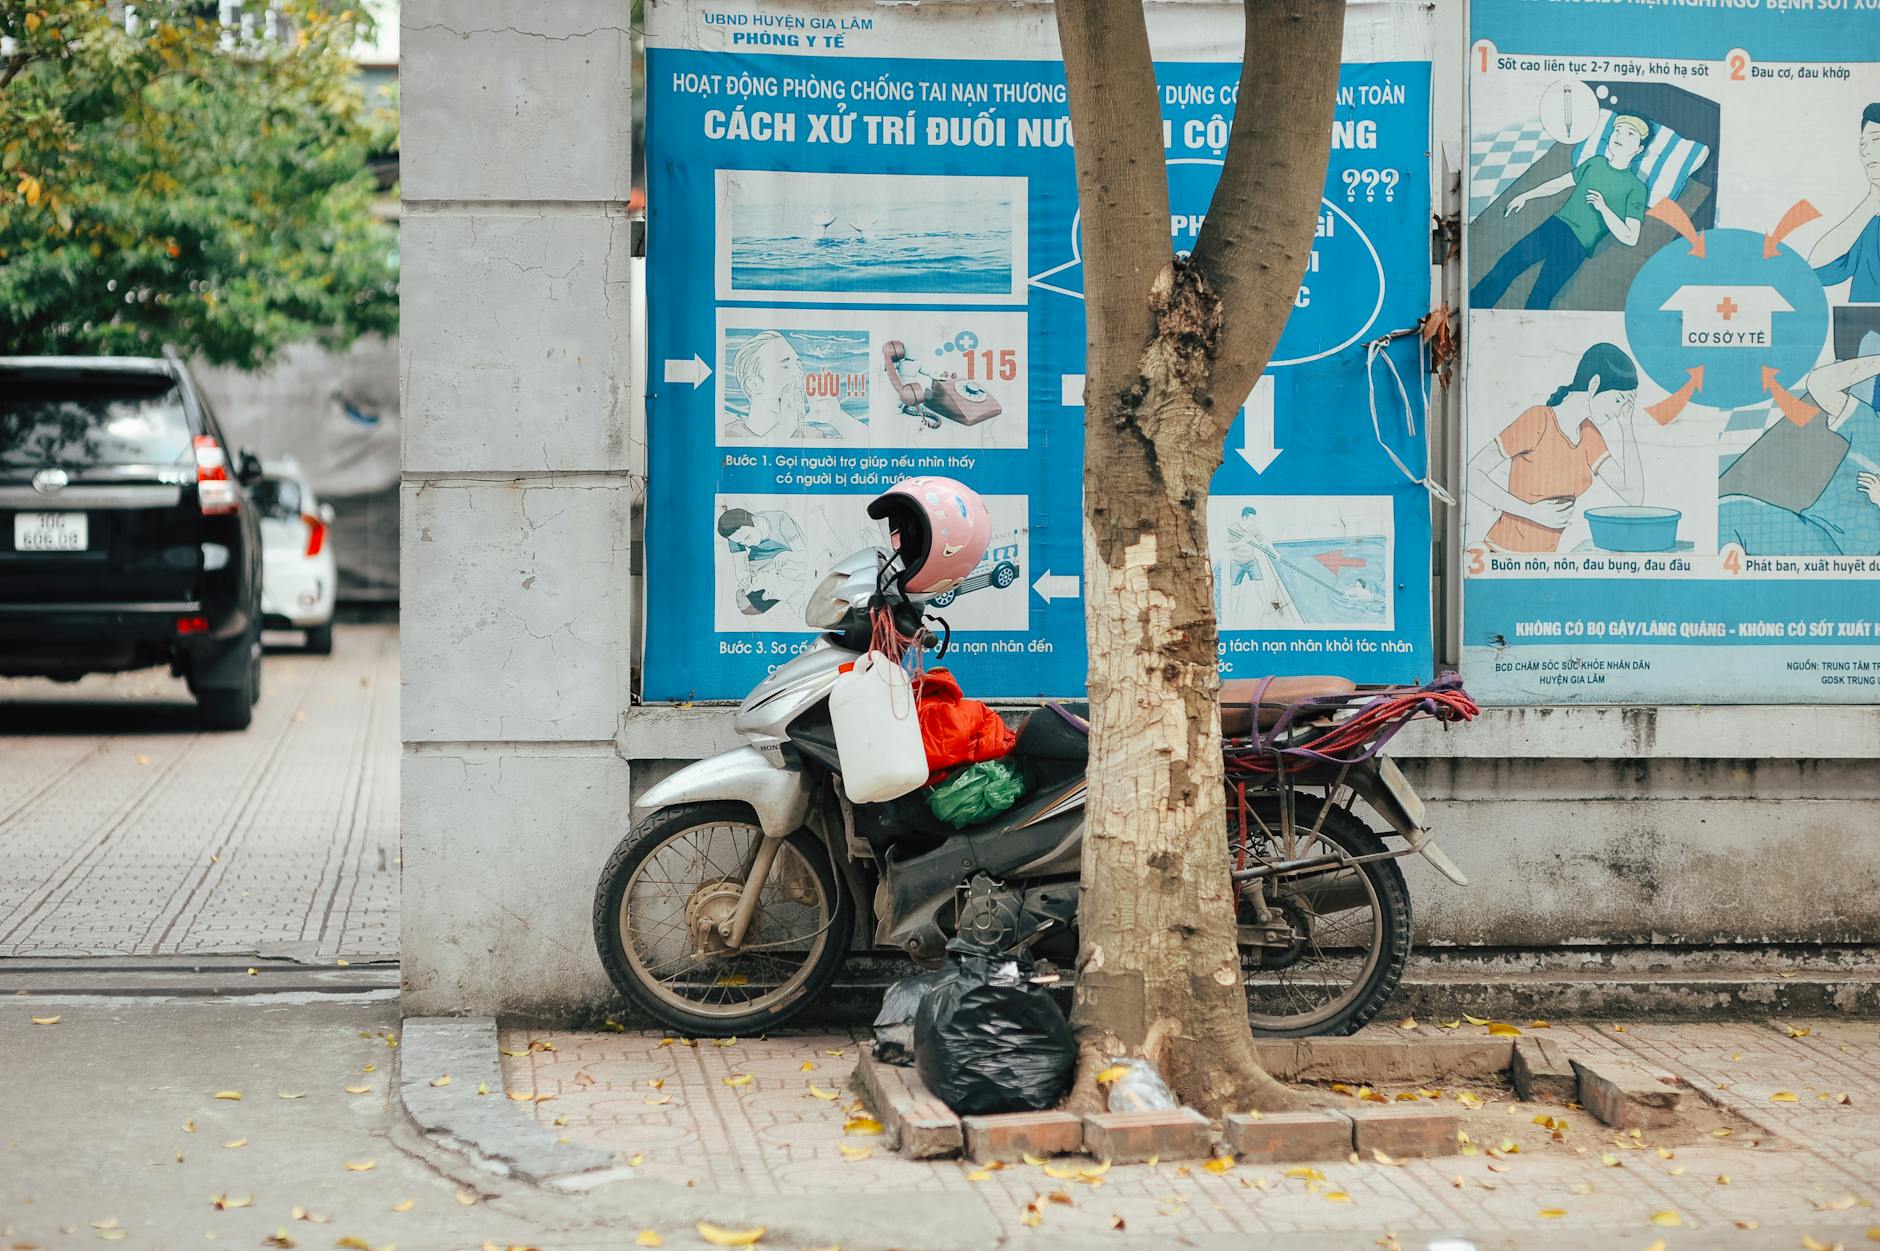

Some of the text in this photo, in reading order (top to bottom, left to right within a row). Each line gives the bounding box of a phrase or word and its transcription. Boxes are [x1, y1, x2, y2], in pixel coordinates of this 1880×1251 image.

[704, 13, 873, 31] UBND HUYỆN GIA LÂM
[733, 30, 846, 48] PHÒNG Y TẾ
[1478, 46, 1488, 72] 1
[1497, 58, 1709, 78] Sốt cao liên tục 2-7 ngày, khó hạ sốt
[1730, 55, 1746, 81] 2
[1751, 65, 1850, 81] Đau cơ, đau khớp
[673, 72, 722, 99] HOẠT
[726, 71, 778, 100] ĐỘNG
[783, 73, 846, 99] PHÒNG
[850, 73, 914, 101] CHỐNG
[919, 82, 946, 102] TAI
[951, 83, 988, 107] NẠN
[993, 82, 1067, 103] THƯƠNG
[1165, 84, 1215, 110] DỰNG
[1358, 79, 1405, 105] TOÀN
[704, 105, 796, 142] CÁCH
[807, 102, 858, 144] XỬ
[863, 110, 916, 145] TRÍ
[926, 107, 1006, 147] ĐUỐI
[1184, 114, 1234, 155] CỘ
[1331, 120, 1377, 149] NG
[1688, 332, 1709, 343] CƠ
[1712, 330, 1734, 344] SỞ
[1737, 332, 1745, 343] Y
[962, 349, 1017, 381] 115
[805, 367, 840, 397] CỨU
[725, 454, 976, 469] Bước 1. Gọi người trợ giúp nếu nhìn thấy
[776, 472, 793, 484] có
[796, 473, 831, 487] người
[835, 473, 847, 485] bị
[850, 473, 878, 484] đuối
[1468, 549, 1485, 575] 3
[1491, 557, 1691, 573] Buồn nôn, nôn, đau bụng, đau đầu
[1723, 550, 1741, 576] 4
[1746, 559, 1773, 572] Phát
[1776, 560, 1800, 573] ban,
[1804, 559, 1830, 572] xuất
[1833, 558, 1865, 574] huyết
[1516, 619, 1561, 637] KHÔNG
[1565, 619, 1584, 636] CÓ
[1587, 621, 1606, 639] BỌ
[1739, 620, 1784, 637] KHÔNG
[1787, 619, 1806, 636] CÓ
[1809, 618, 1834, 637] SỐT
[1837, 618, 1872, 637] XUẤT
[719, 640, 752, 654] Bước
[756, 641, 767, 654] 3.
[771, 642, 787, 654] Sơ
[963, 641, 988, 656] nạn
[991, 640, 1024, 653] nhân
[1027, 638, 1053, 653] đến
[1229, 640, 1259, 652] tách
[1262, 641, 1288, 655] nạn
[1290, 639, 1323, 652] nhân
[1325, 637, 1353, 652] khỏi
[1355, 638, 1377, 652] tác
[1381, 639, 1413, 652] nhân
[1495, 663, 1512, 672] BCĐ
[1542, 659, 1560, 670] SÓC
[1606, 660, 1630, 670] NHÂN
[1632, 660, 1650, 670] DÂN
[1822, 662, 1850, 671] TRUNG
[1853, 660, 1870, 671] TÂM
[1539, 673, 1568, 686] HUYỆN
[1570, 675, 1585, 684] GIA
[1821, 676, 1845, 685] GDSK
[1847, 676, 1875, 685] TRUNG
